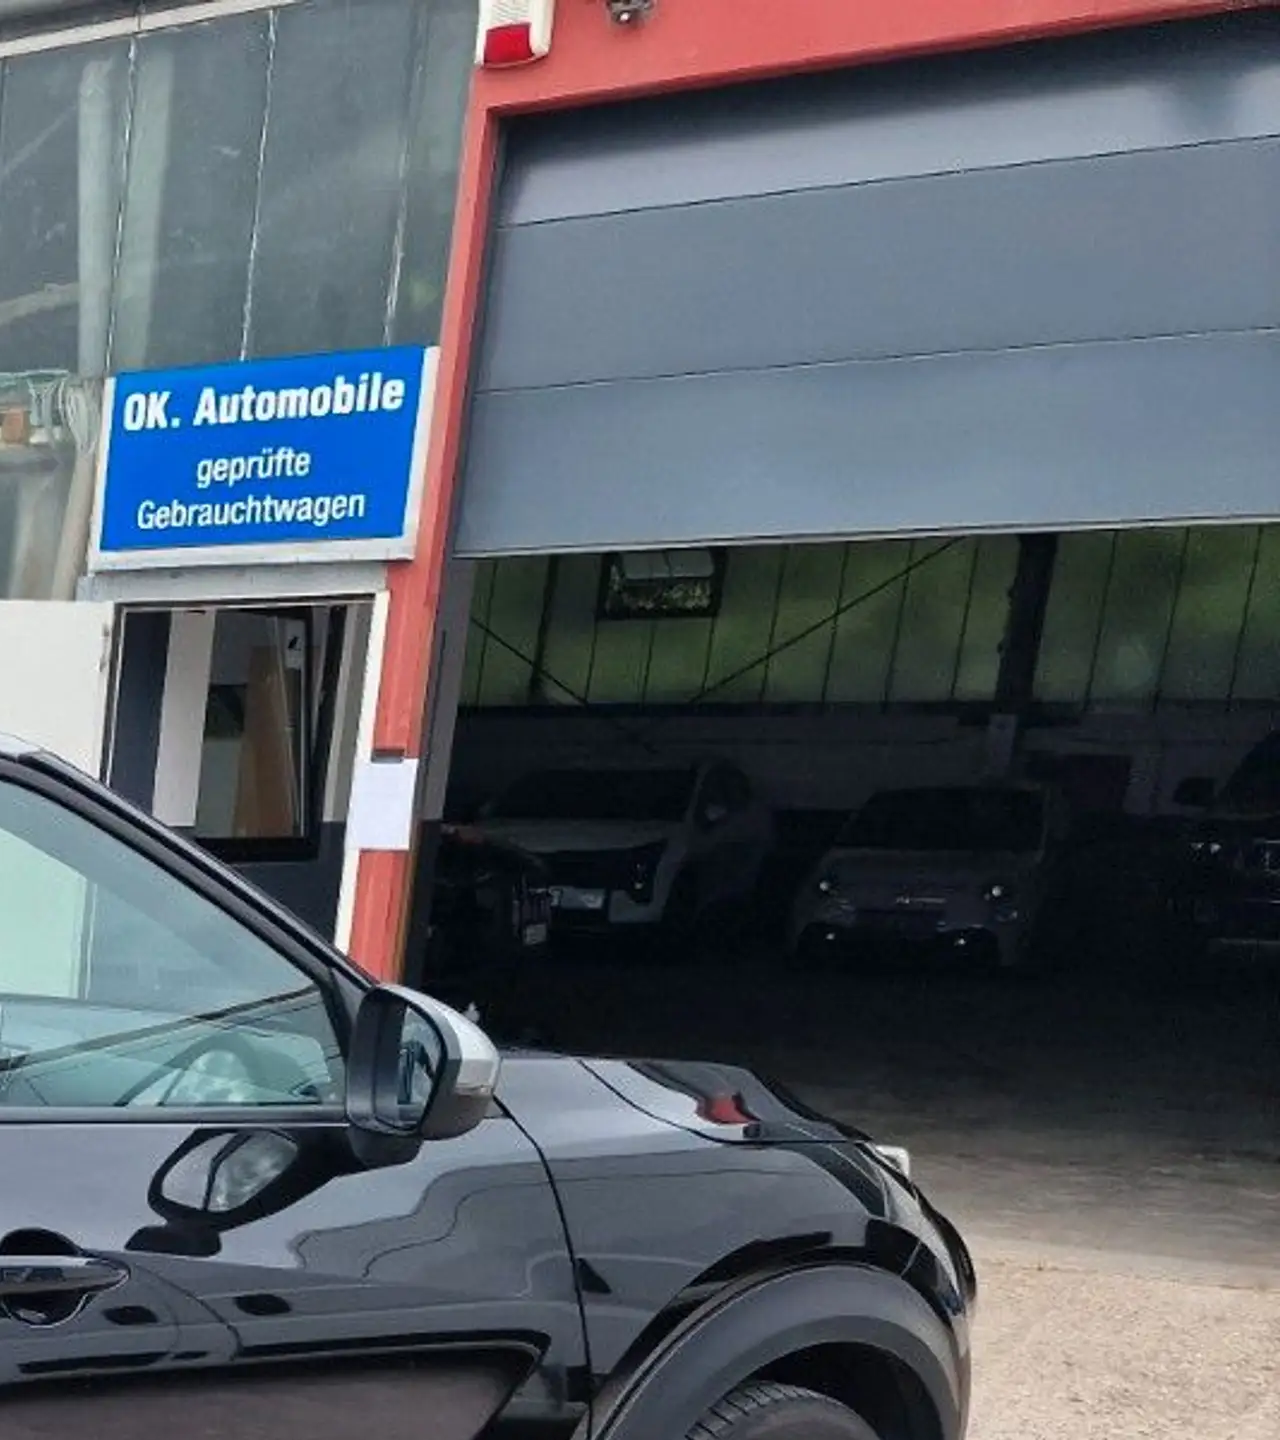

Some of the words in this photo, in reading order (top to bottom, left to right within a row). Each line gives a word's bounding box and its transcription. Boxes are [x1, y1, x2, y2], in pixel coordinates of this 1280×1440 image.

[123, 391, 181, 431] OK.
[192, 372, 406, 427] Automobile
[196, 446, 311, 488] geprüfte
[137, 494, 365, 529] Gebrauchtwagen
